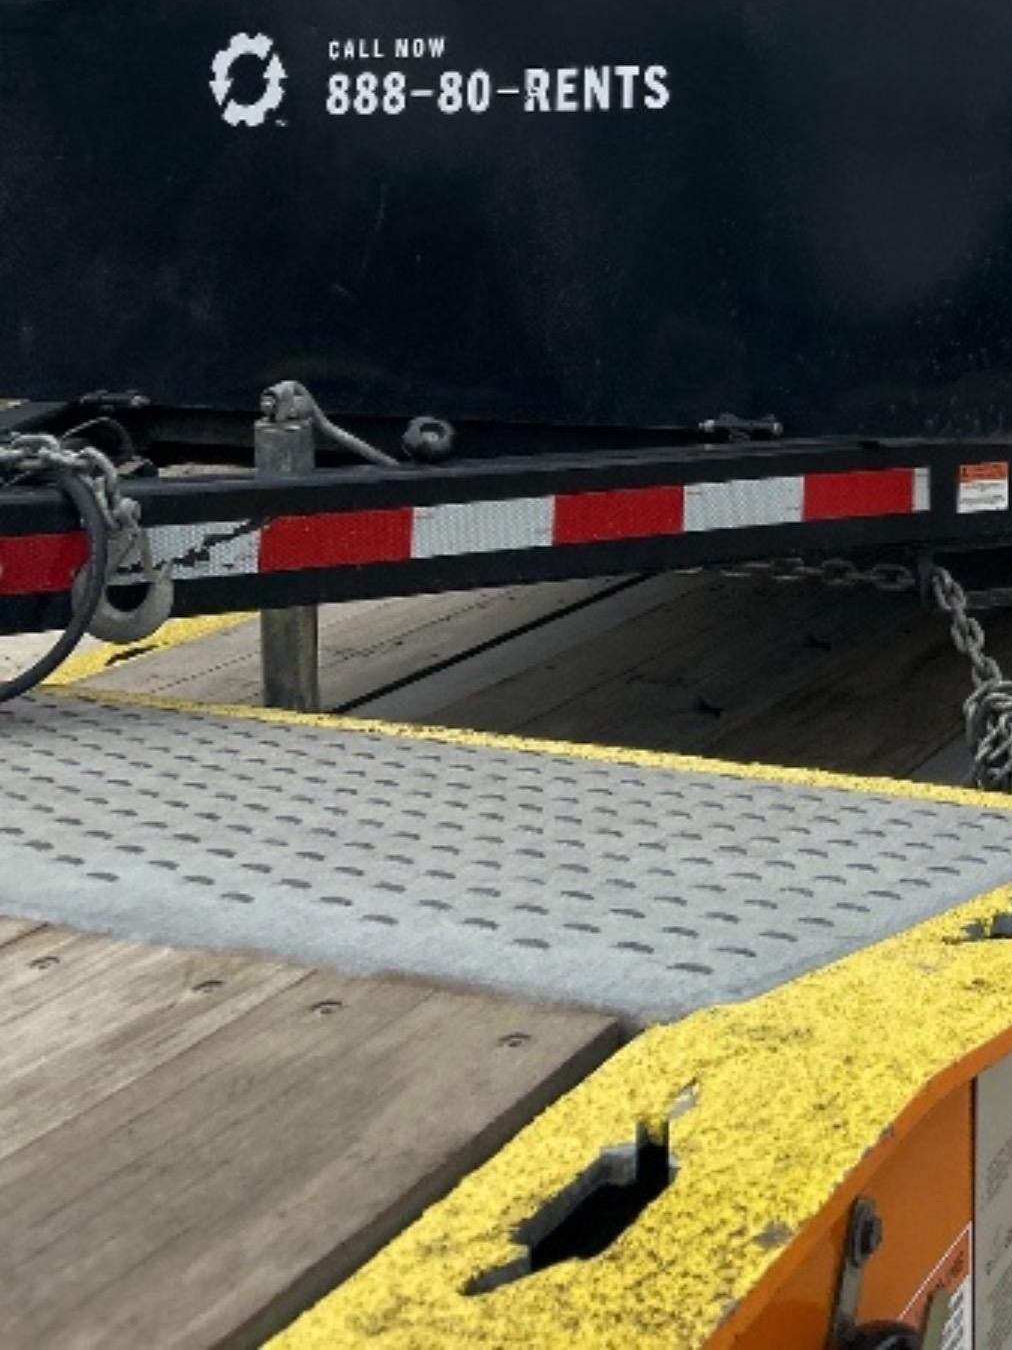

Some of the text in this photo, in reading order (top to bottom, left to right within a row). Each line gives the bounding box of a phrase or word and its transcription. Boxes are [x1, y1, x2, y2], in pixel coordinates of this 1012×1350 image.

[328, 36, 447, 61] CALL NOW
[325, 64, 671, 116] 888-80-RENTS
